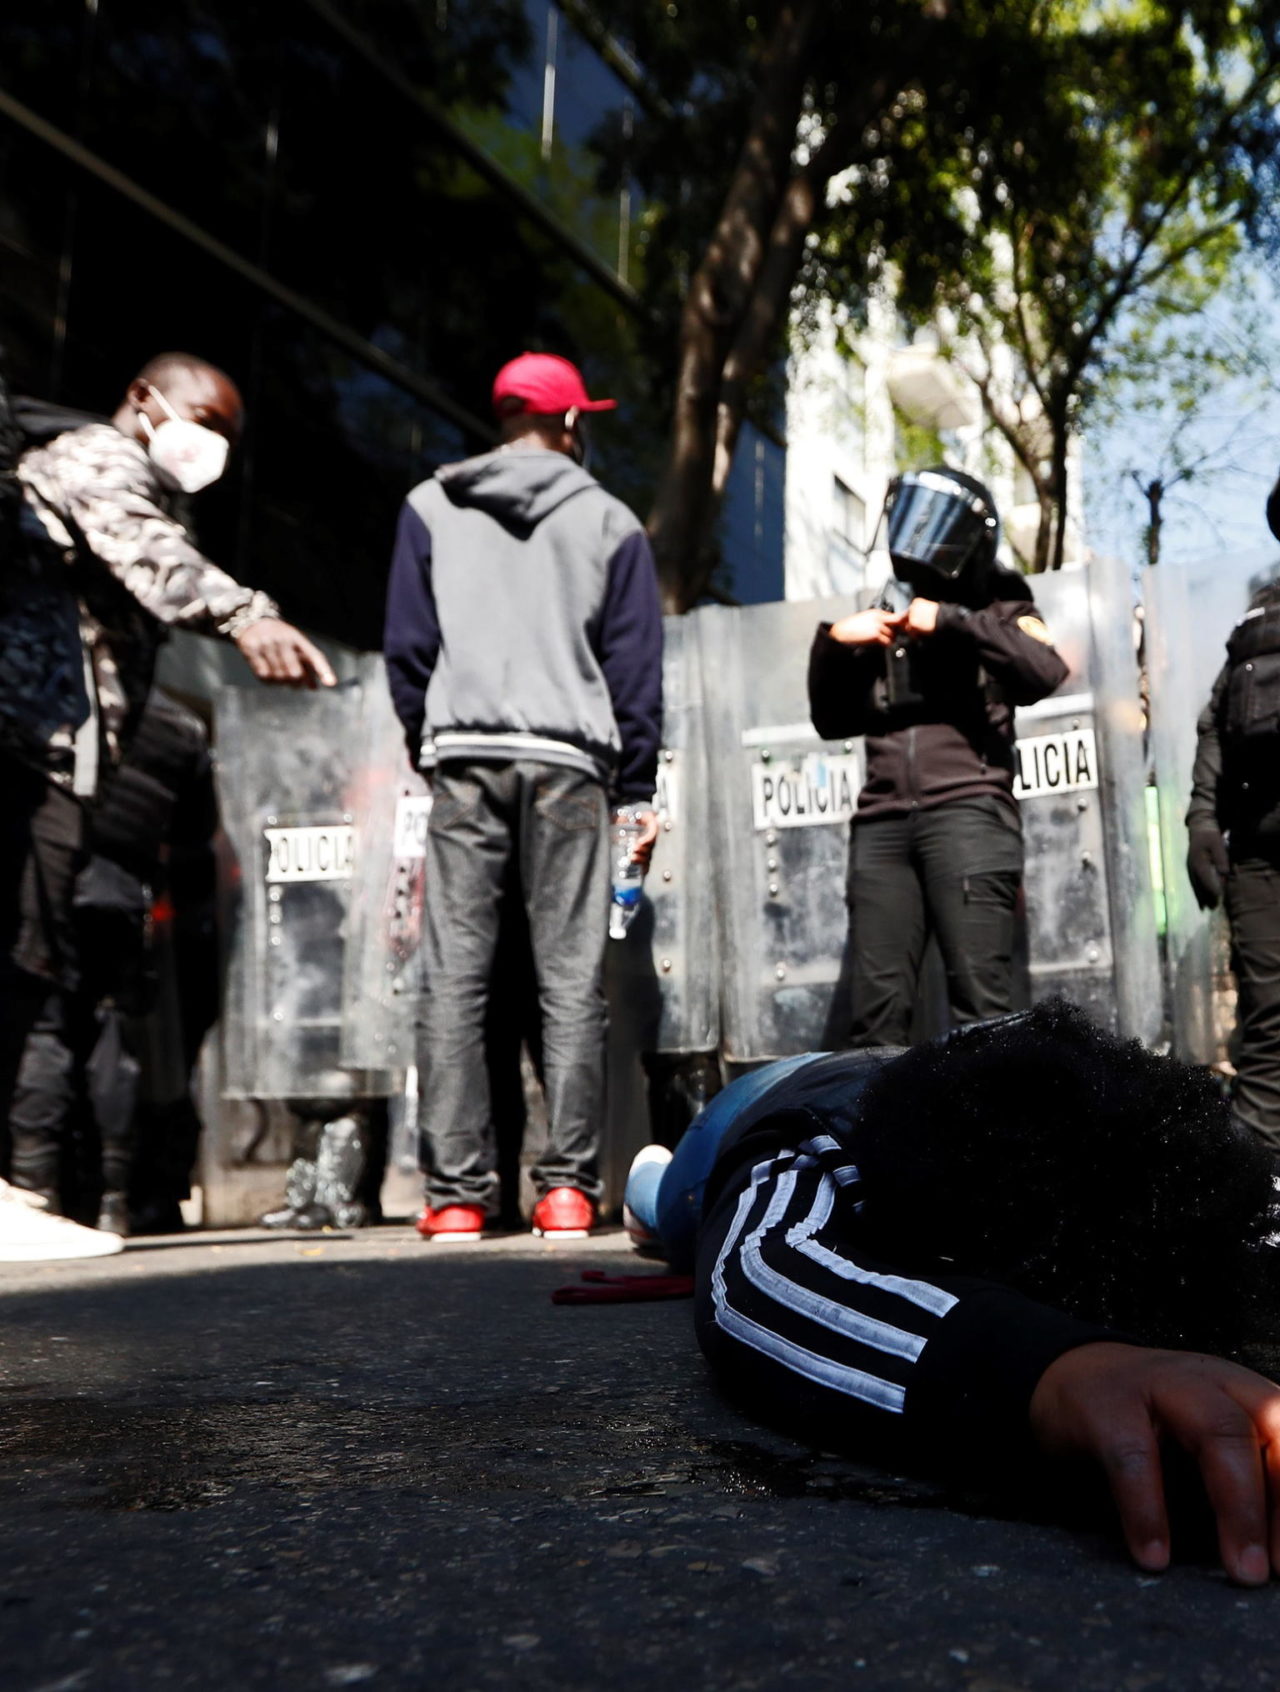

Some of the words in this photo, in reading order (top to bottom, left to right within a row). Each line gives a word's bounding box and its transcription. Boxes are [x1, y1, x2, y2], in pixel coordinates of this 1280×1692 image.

[1017, 739, 1092, 791] LICIA
[762, 768, 854, 818] POLICIA
[272, 834, 357, 874] OLICIA
